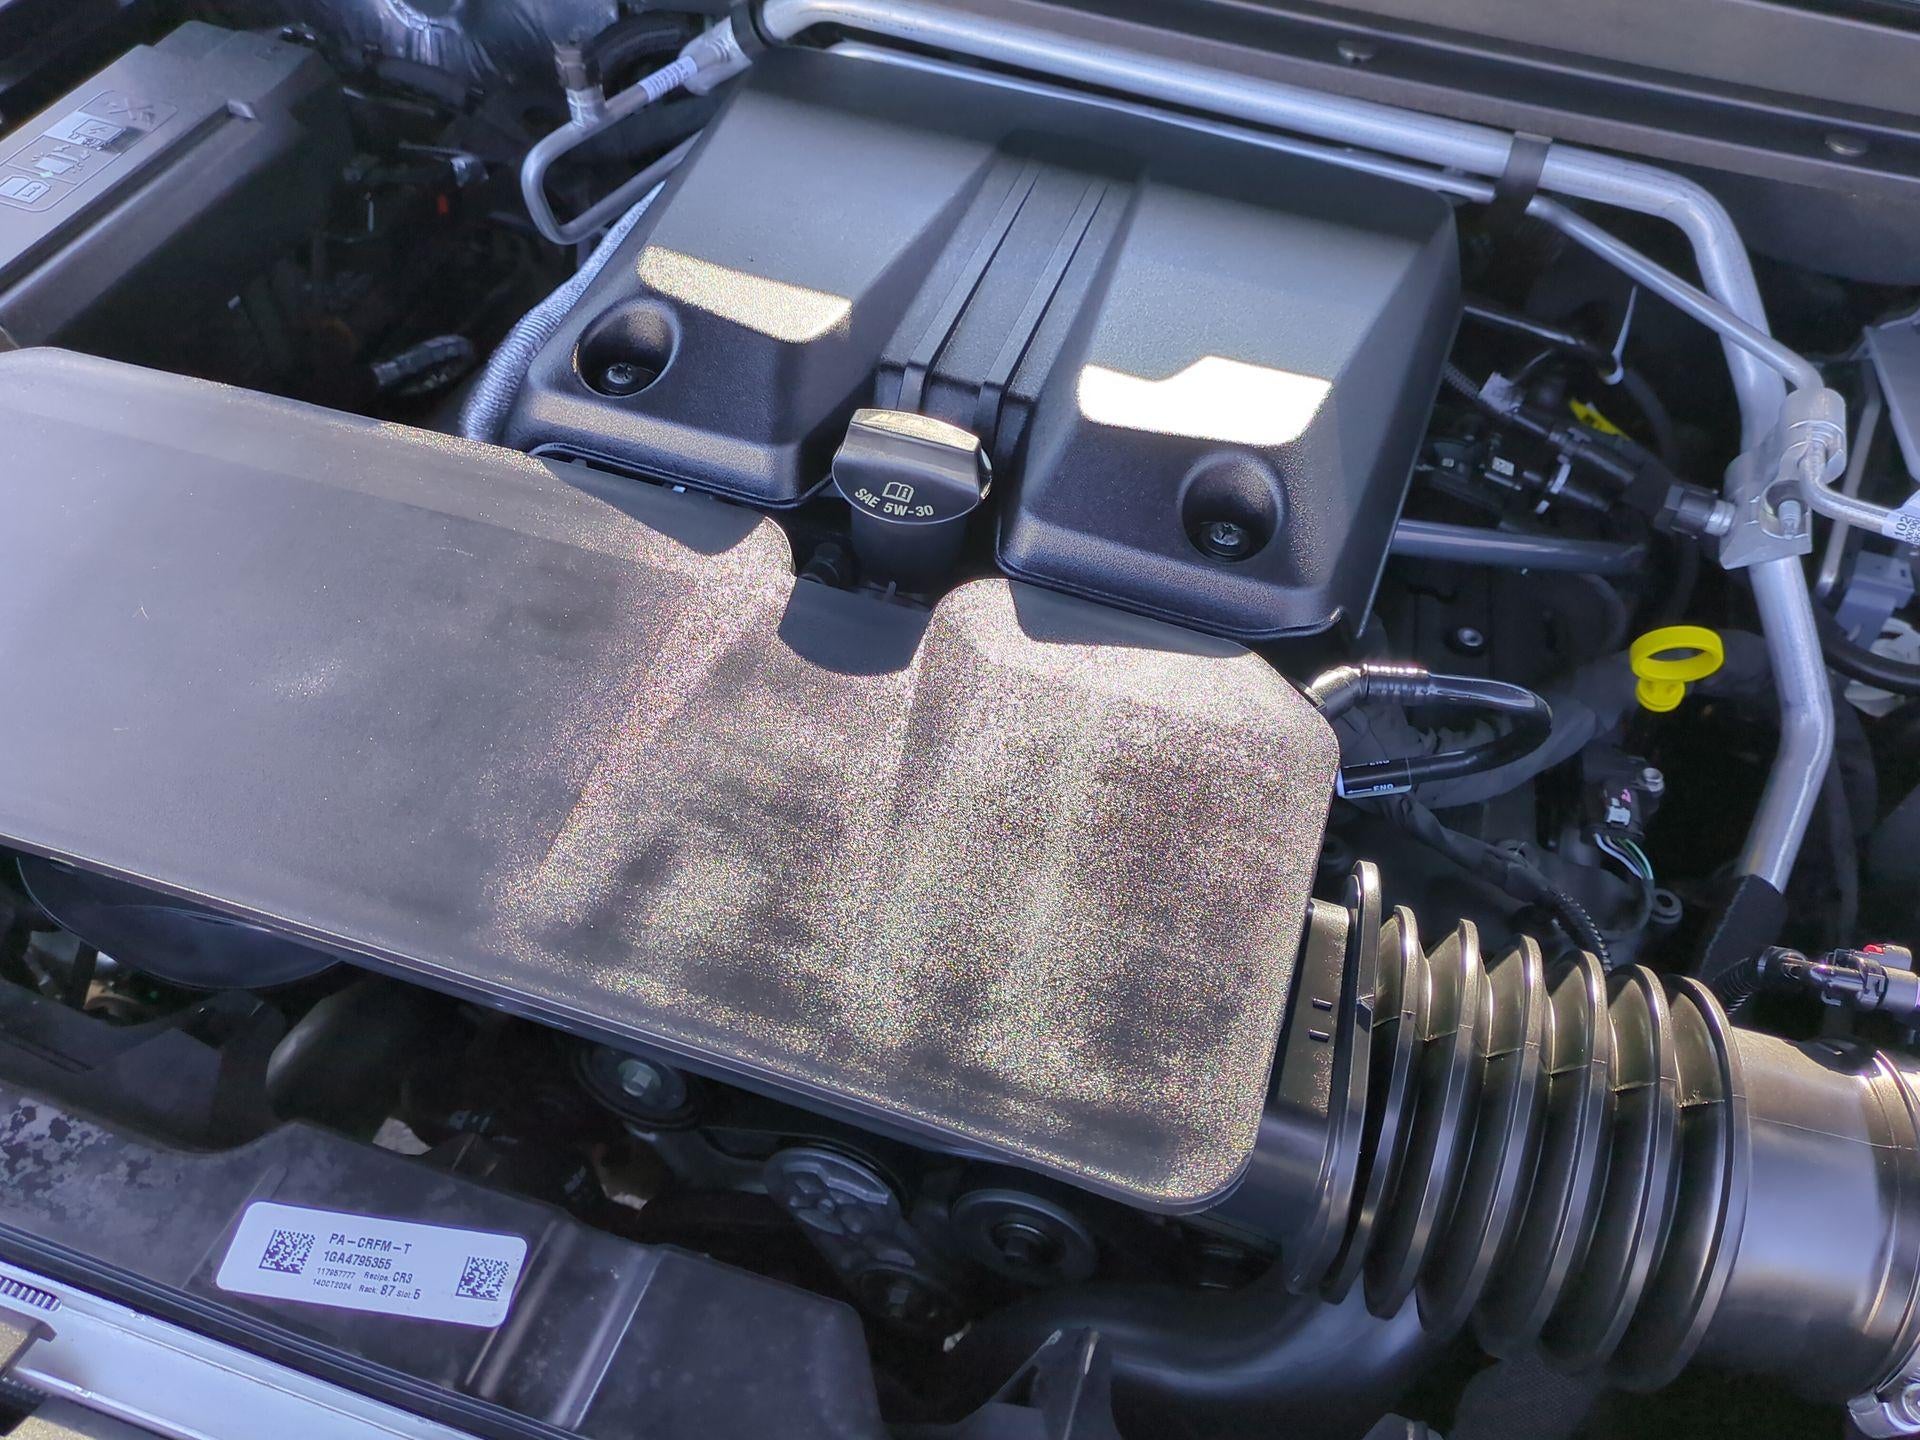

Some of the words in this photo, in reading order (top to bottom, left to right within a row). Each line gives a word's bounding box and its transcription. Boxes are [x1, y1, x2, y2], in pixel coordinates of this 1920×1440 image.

[855, 488, 881, 508] SAE
[883, 503, 935, 517] 5W-30
[392, 1271, 413, 1284] CR3
[380, 1284, 396, 1297] 87
